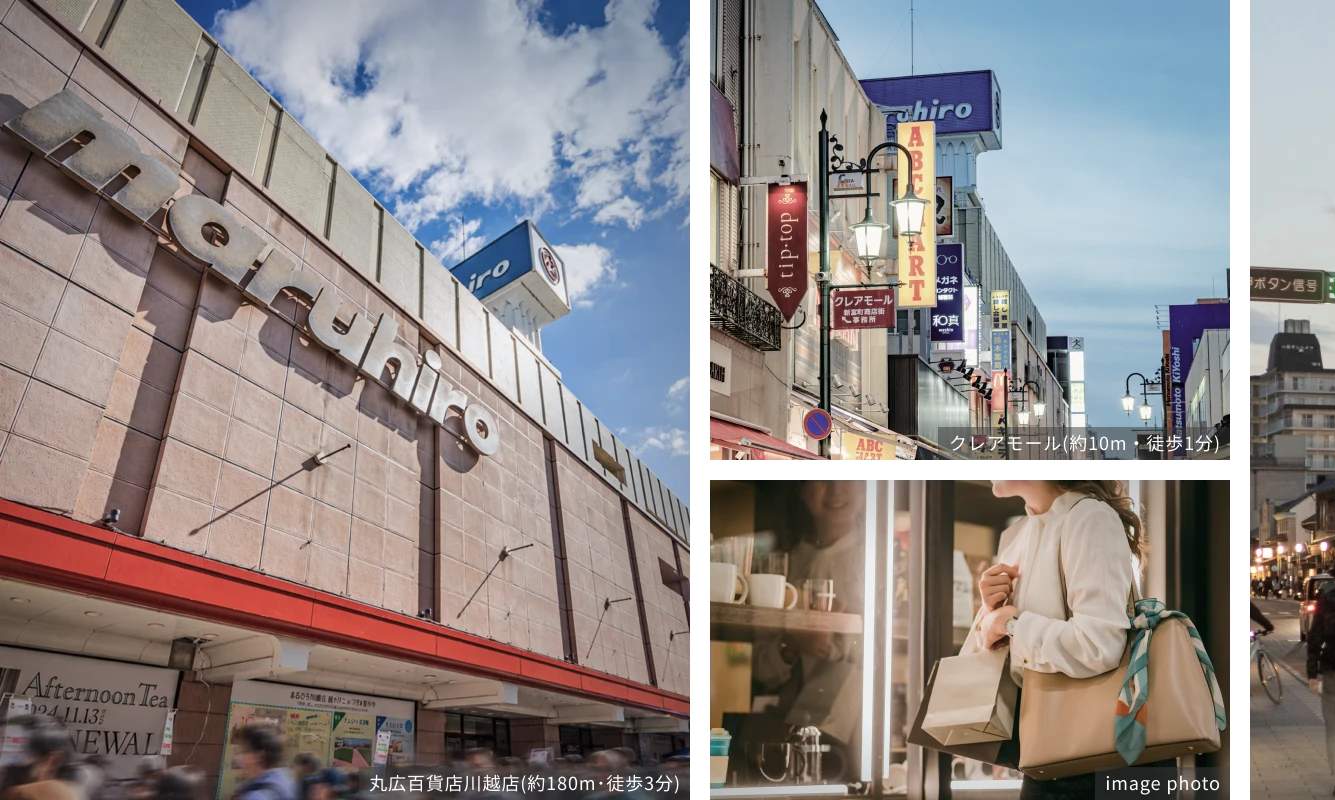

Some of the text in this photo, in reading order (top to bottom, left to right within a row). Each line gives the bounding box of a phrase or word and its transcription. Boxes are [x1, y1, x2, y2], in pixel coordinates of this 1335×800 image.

[3, 88, 500, 456] maruhiro
[467, 259, 511, 293] iro
[835, 295, 893, 307] クレアモール
[843, 308, 885, 316] 新富町商店街
[932, 314, 960, 327] 和真
[1171, 347, 1183, 442] atsumoto KiYoshi
[855, 438, 884, 452] ABC
[22, 671, 169, 709] Afternoon Tea
[69, 729, 161, 756] NEWAL
